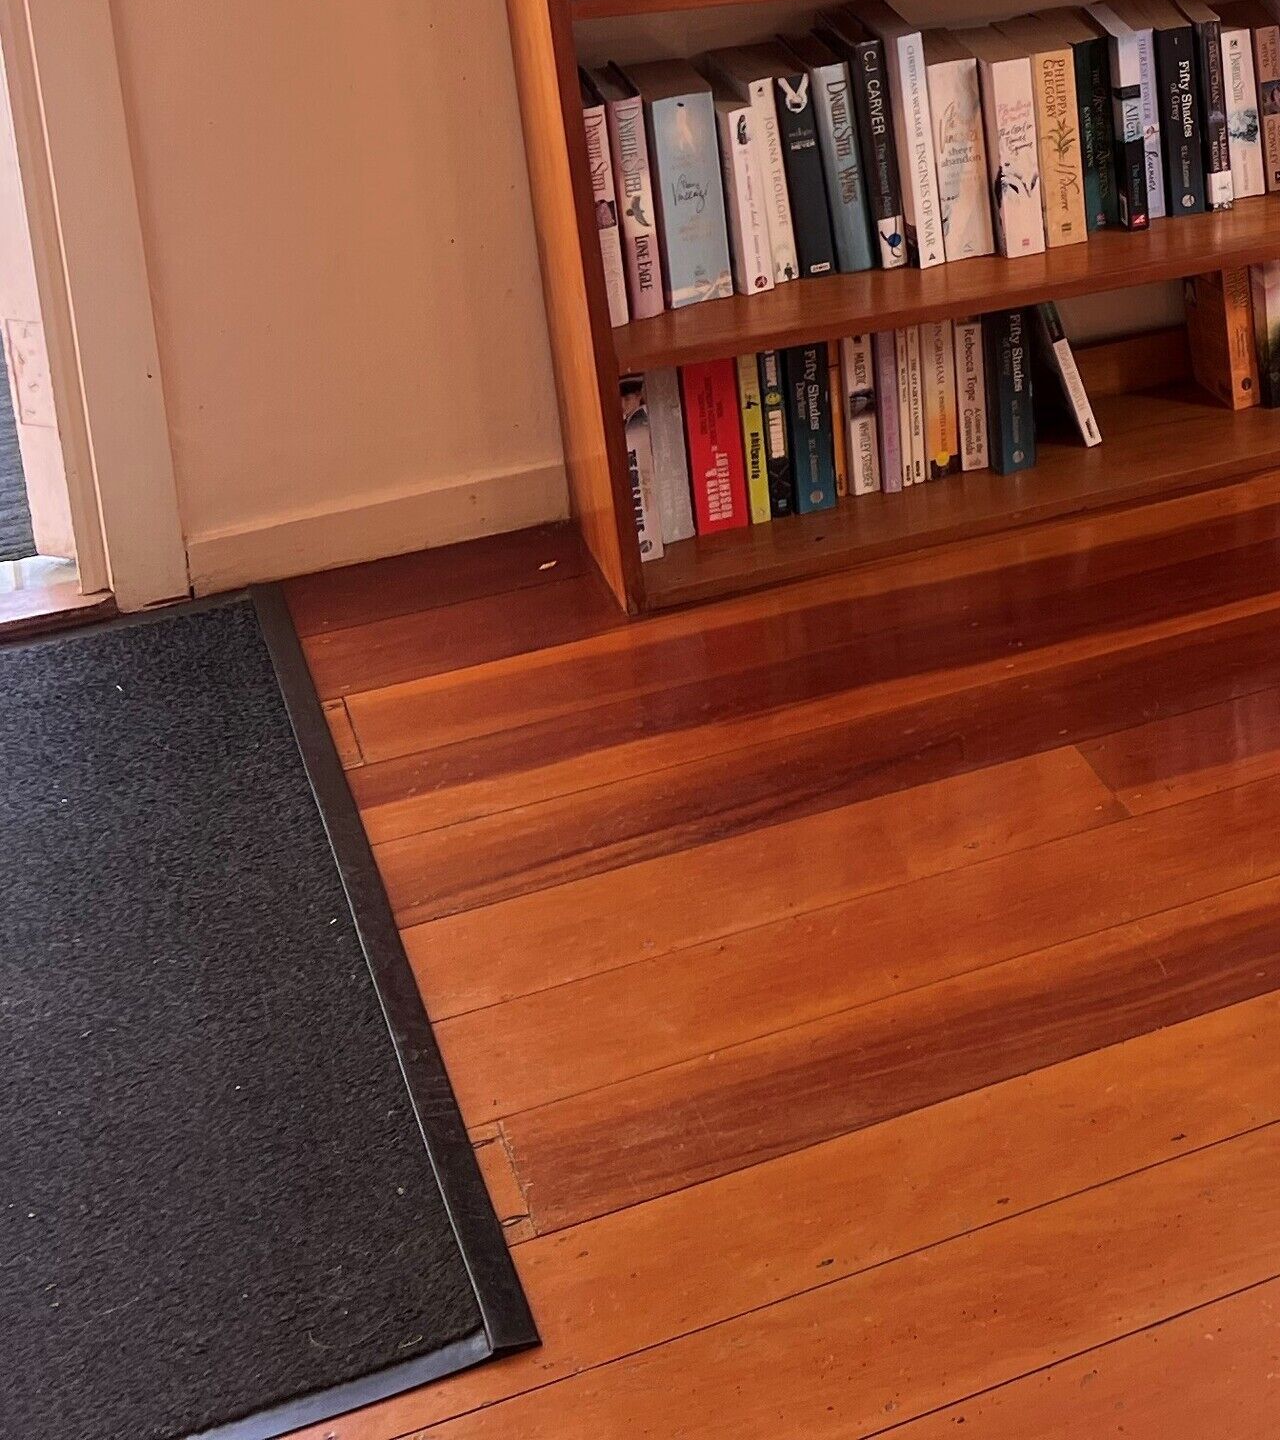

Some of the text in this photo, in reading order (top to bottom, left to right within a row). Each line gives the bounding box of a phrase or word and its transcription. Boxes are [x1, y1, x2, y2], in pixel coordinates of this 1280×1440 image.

[867, 80, 885, 135] CARVER
[1042, 60, 1056, 119] GREGORY
[1053, 59, 1066, 116] PHILIPPA
[1171, 95, 1181, 121] Grey
[1178, 60, 1193, 138] Fifty Shades
[1125, 103, 1140, 140] Allen
[772, 170, 787, 227] TROLLOPE
[838, 165, 859, 205] WINGS
[911, 96, 935, 248] WOLMAR ENGINES OF WAR
[635, 233, 653, 293] LONE EAGLE
[934, 338, 945, 386] GRISHAM
[964, 328, 977, 401] Rebecca Tope
[1009, 314, 1024, 392] Fifty Shades
[803, 349, 821, 431] Fifty Shades
